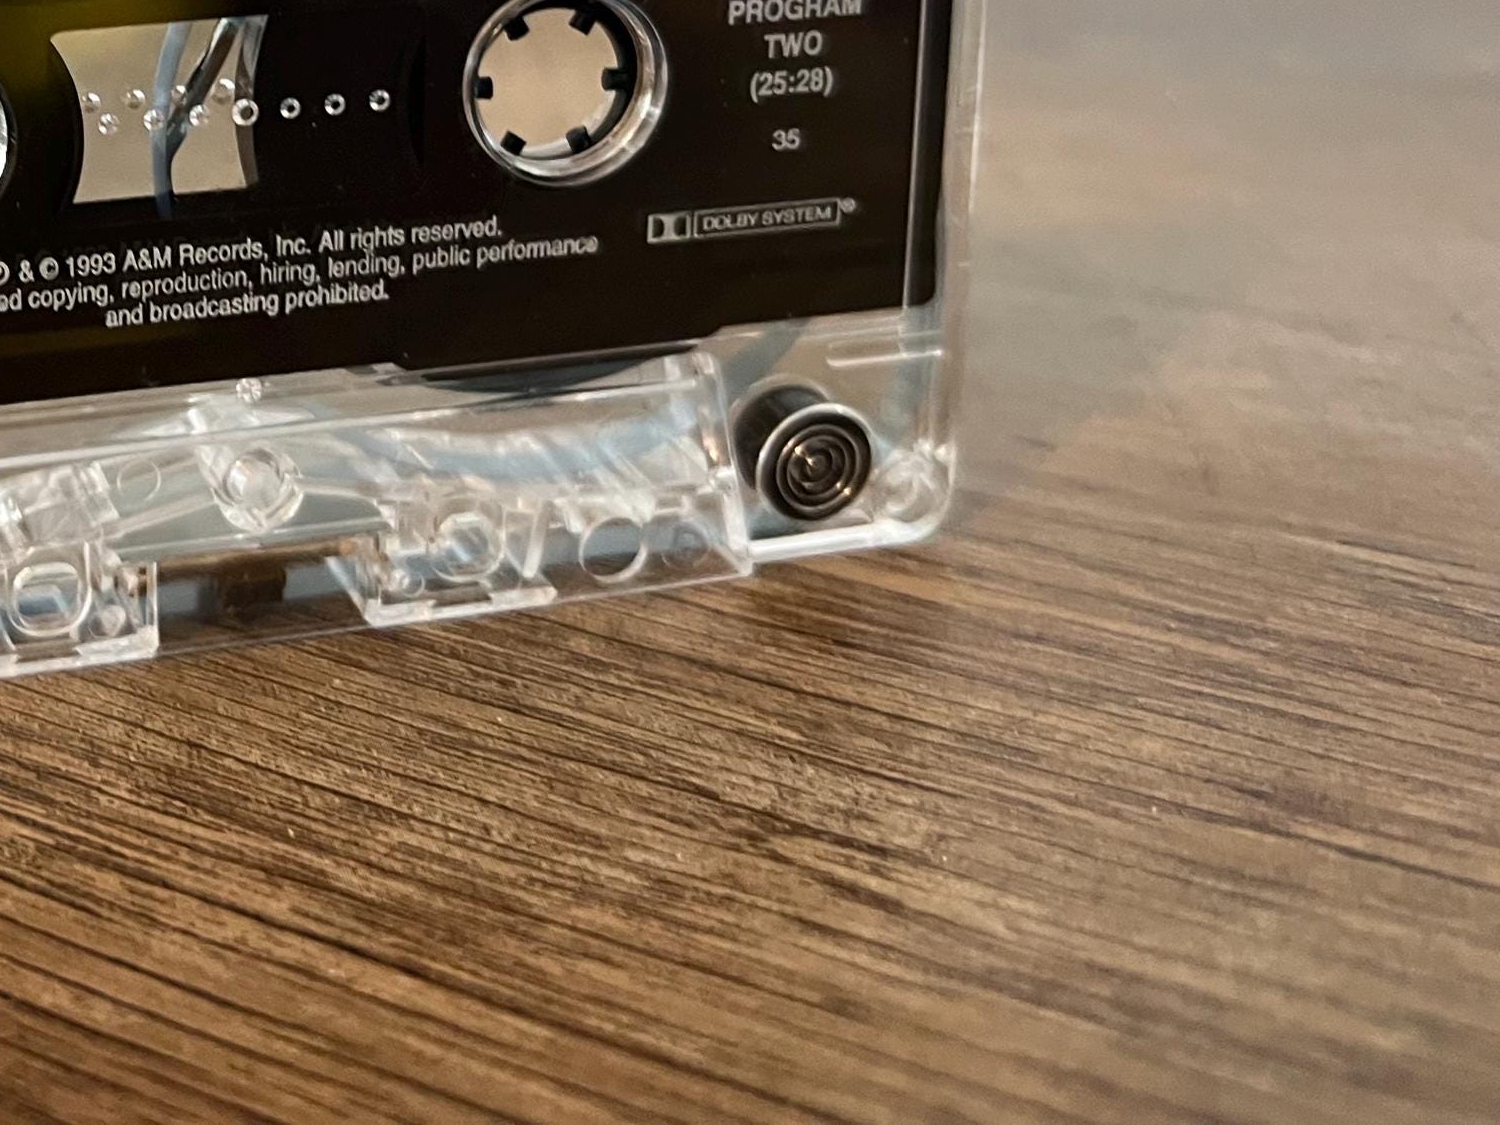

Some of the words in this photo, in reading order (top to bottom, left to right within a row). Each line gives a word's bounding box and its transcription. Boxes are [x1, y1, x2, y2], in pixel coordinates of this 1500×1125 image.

[764, 31, 822, 58] TWO
[750, 66, 833, 103] (25:28)
[772, 128, 800, 150] 35
[703, 212, 759, 230] DOLBY
[762, 206, 832, 225] SYSTEM
[18, 260, 34, 282] &
[65, 252, 116, 276] 1993
[122, 246, 171, 271] A&M
[179, 237, 268, 266] Records,
[276, 234, 311, 256] Inc.
[318, 230, 344, 253] All
[350, 224, 404, 252] rights
[411, 215, 502, 244] reserved.
[28, 281, 114, 311] copying,
[121, 267, 253, 302] reproduction,
[260, 261, 320, 287] hiring,
[328, 251, 405, 278] lending,
[412, 243, 470, 275] public
[477, 236, 598, 268] performance
[105, 303, 143, 328] and
[149, 287, 279, 323] broadcasting
[285, 278, 389, 314] prohibited.
